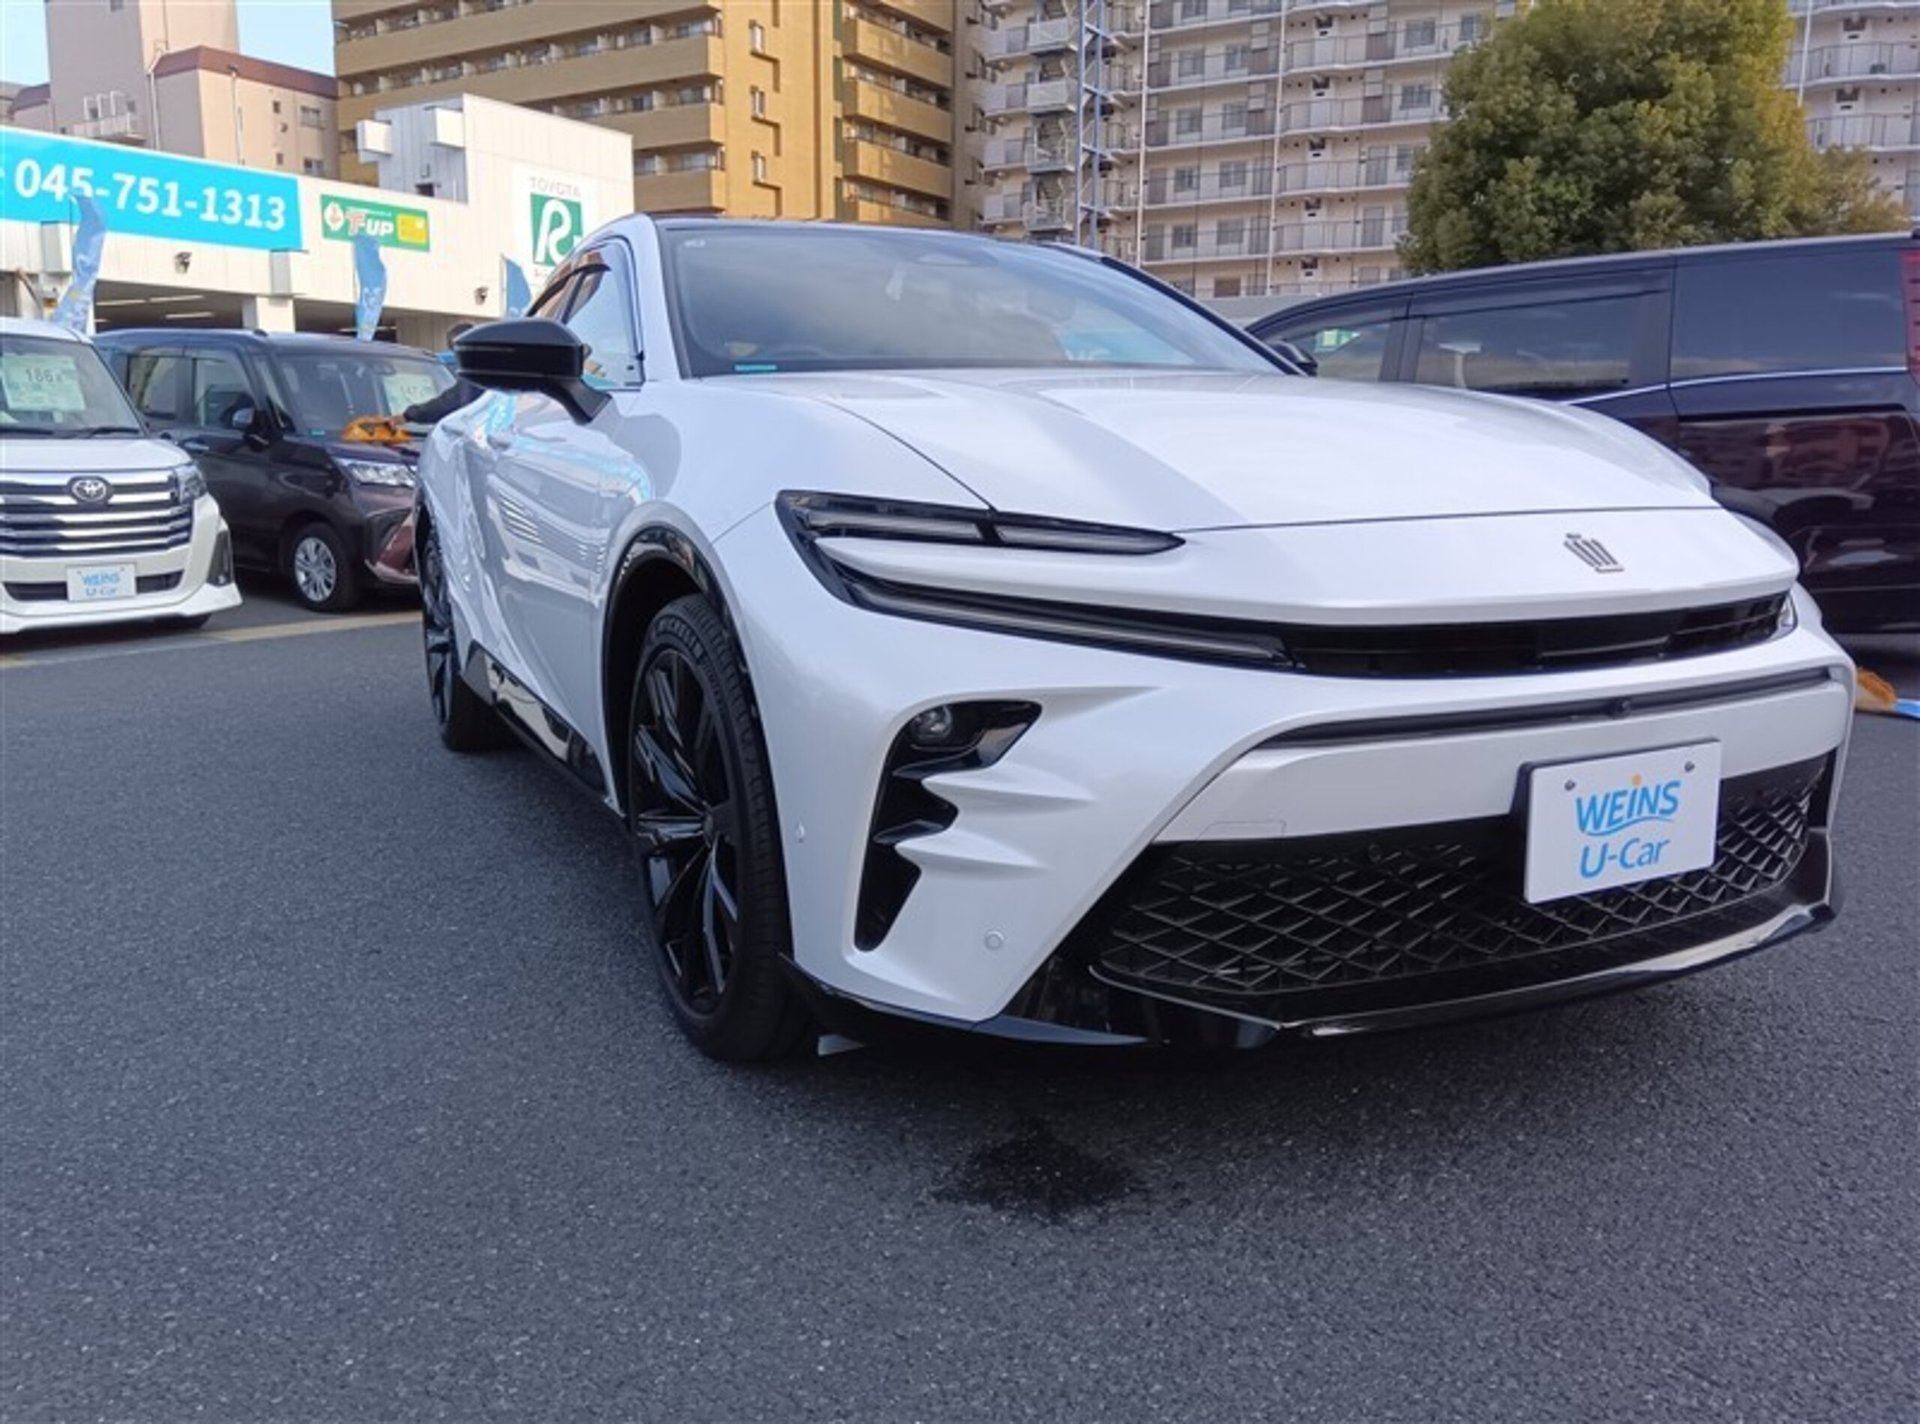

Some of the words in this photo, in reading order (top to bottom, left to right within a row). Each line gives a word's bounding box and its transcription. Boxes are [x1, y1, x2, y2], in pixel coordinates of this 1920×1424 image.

[14, 158, 287, 232] 045-751-1313
[529, 177, 581, 197] TOYOTA
[1575, 774, 1682, 834] WEINS
[1580, 837, 1671, 879] U-Car
